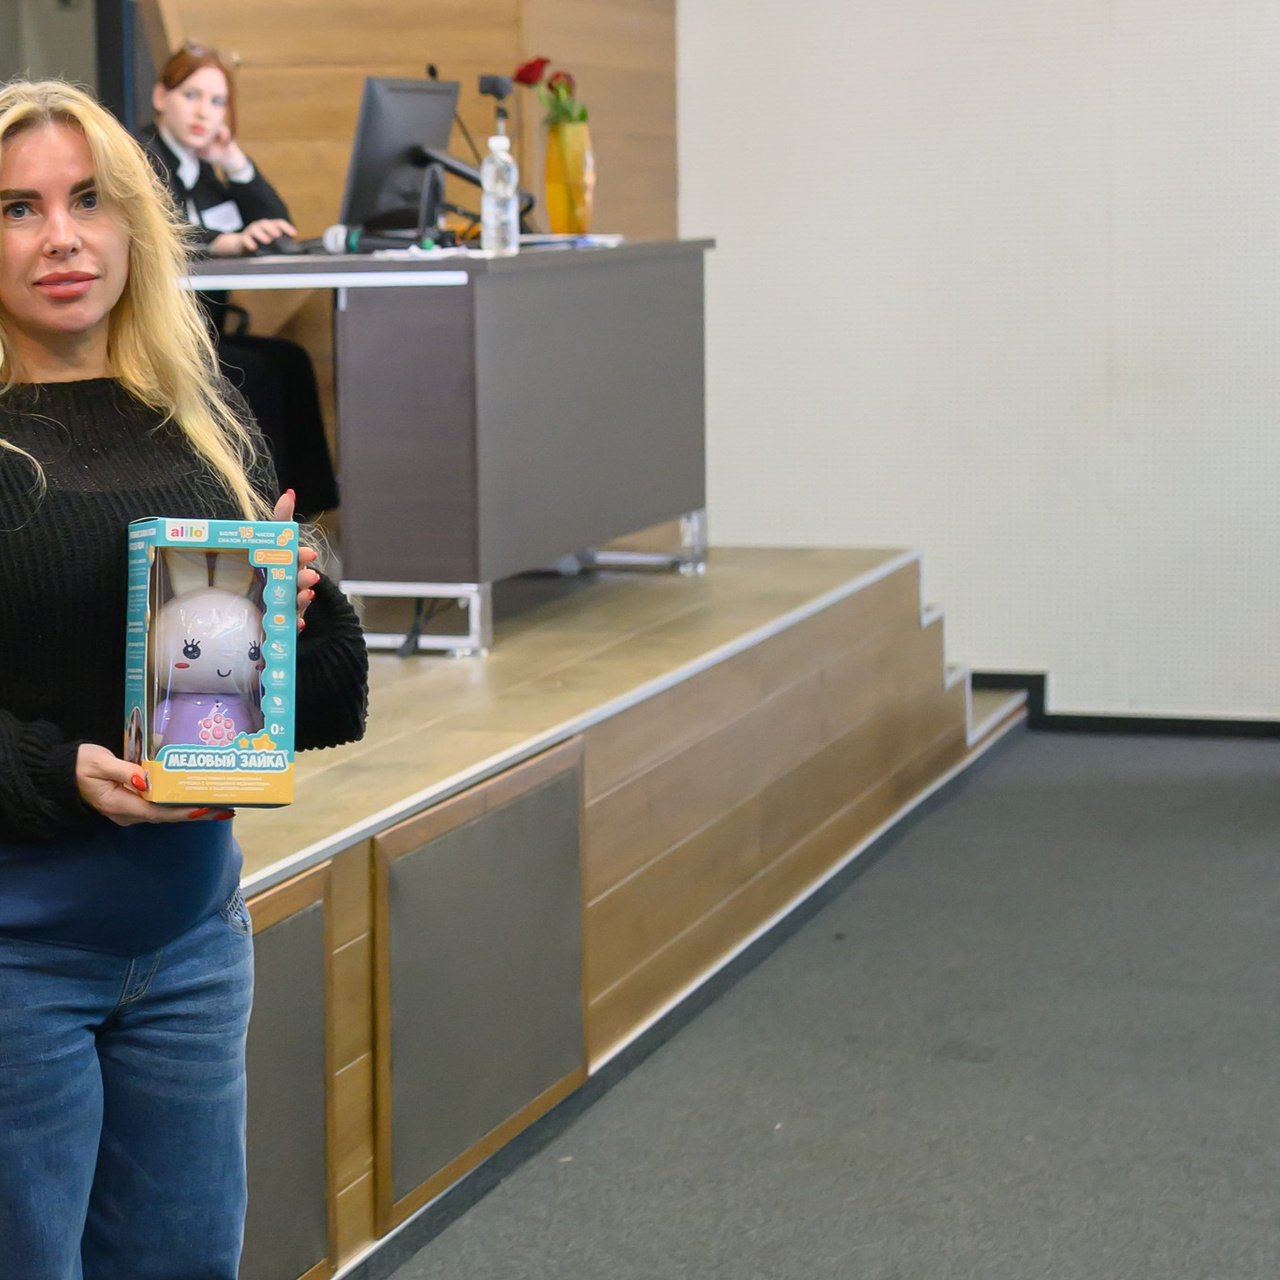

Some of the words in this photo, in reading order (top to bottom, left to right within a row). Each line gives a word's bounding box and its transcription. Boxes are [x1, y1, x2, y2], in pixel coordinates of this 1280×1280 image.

[170, 526, 204, 538] alilo
[238, 527, 254, 538] 15
[270, 568, 286, 580] 16
[270, 723, 286, 735] 0+
[168, 750, 236, 768] МЕДОВЫЙ
[240, 750, 286, 768] ЗАЙКА
